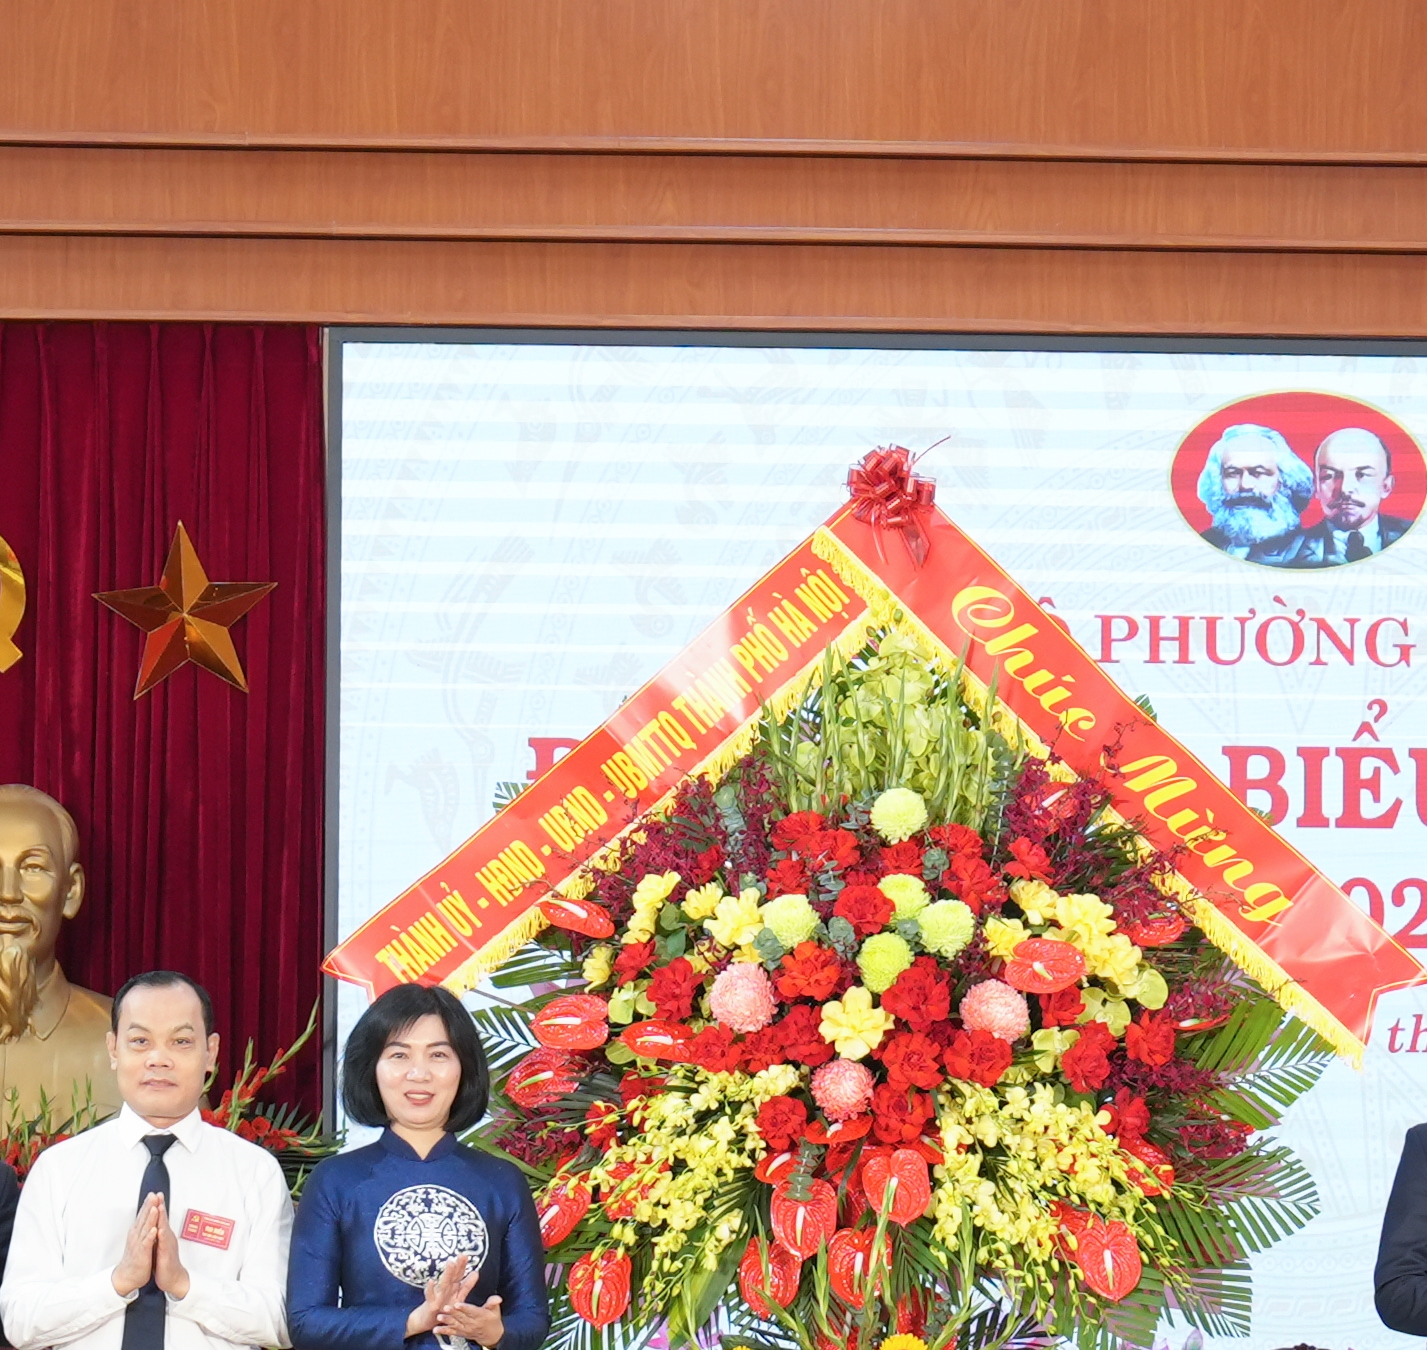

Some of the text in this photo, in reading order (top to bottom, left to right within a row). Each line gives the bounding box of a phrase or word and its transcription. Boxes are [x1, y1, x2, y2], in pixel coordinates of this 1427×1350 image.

[374, 911, 459, 984] THÀNH
[435, 881, 483, 938] ỦY
[474, 839, 546, 907] HĐND
[537, 785, 609, 853] UBND
[670, 656, 753, 736] THÀNH
[728, 606, 790, 684] PHỐ
[767, 591, 819, 649] HÀ
[794, 566, 851, 625] NỘI
[950, 585, 1294, 929] Chúc Mừng
[1093, 595, 1417, 669] PHƯỜNG
